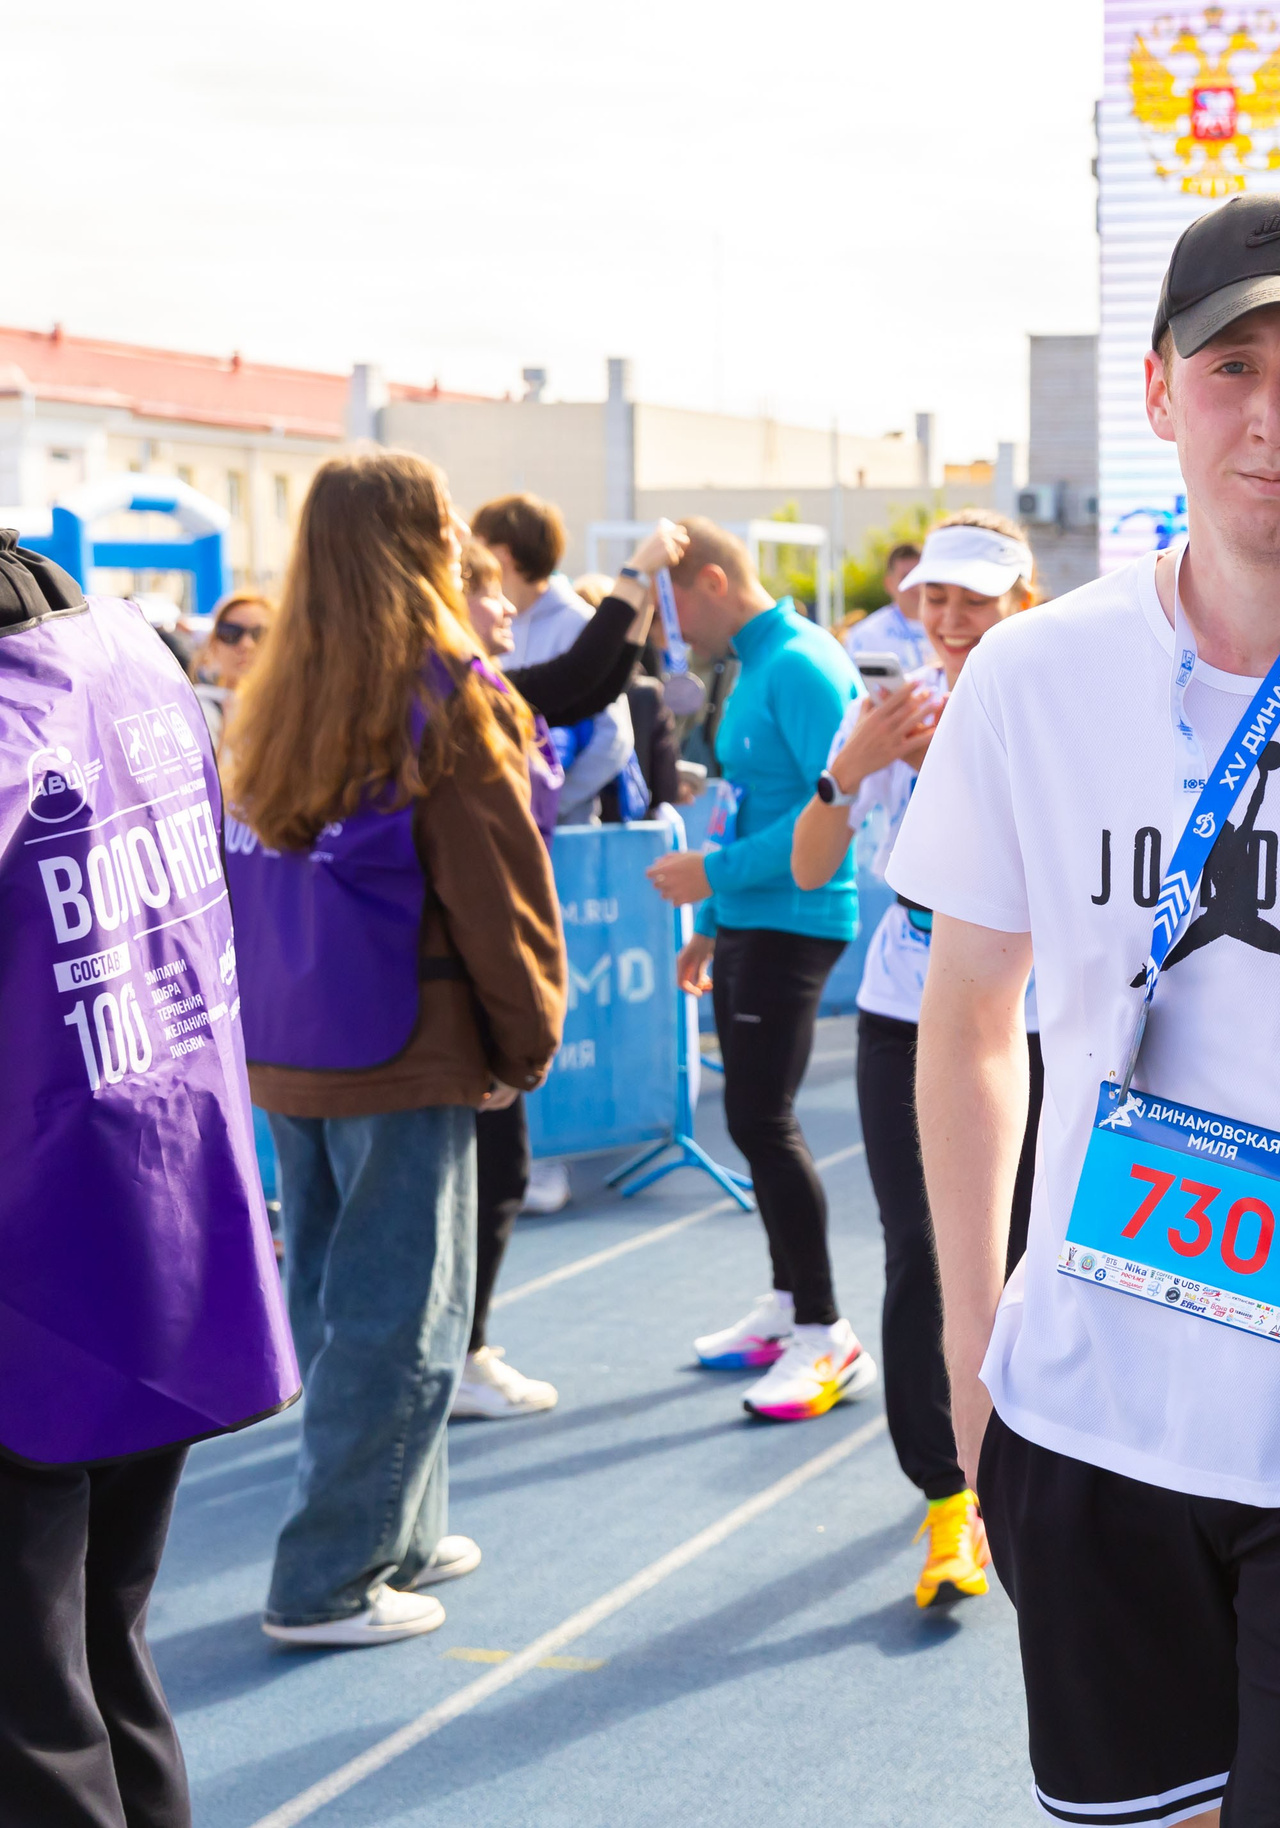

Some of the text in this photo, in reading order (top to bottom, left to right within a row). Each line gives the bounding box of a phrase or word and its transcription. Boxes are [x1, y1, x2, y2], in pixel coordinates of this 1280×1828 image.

[1219, 752, 1247, 791] XV
[144, 959, 187, 986] ЭМПАТИИ
[151, 982, 181, 1005] ДОБРА
[157, 994, 205, 1022] ТЕРПЕНИЯ
[163, 1012, 210, 1041] ЖЕЛАНИЯ
[169, 1035, 205, 1059] ЛЮБВИ
[1187, 1133, 1239, 1161] МИЛЯ
[1120, 1163, 1276, 1275] 730
[1124, 1262, 1148, 1277] Nika
[1181, 1280, 1201, 1292] UDS
[1180, 1299, 1207, 1314] Effort
